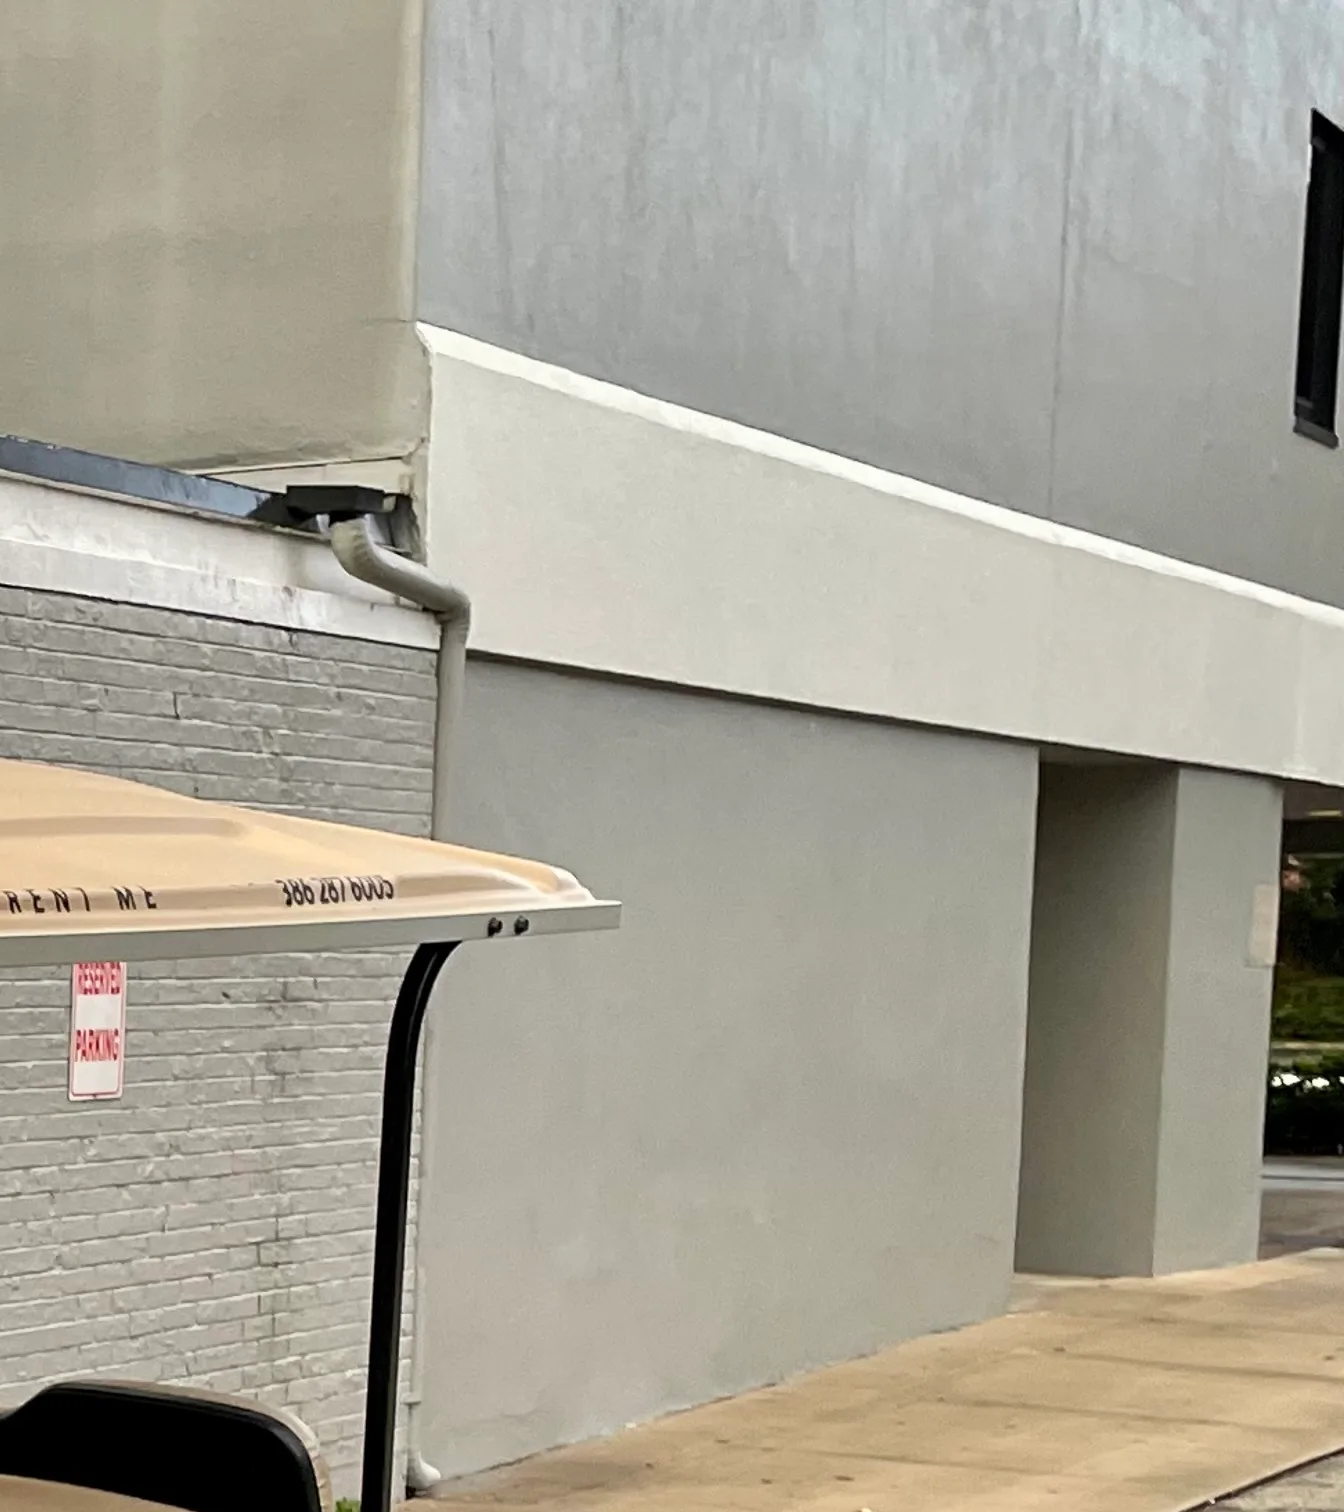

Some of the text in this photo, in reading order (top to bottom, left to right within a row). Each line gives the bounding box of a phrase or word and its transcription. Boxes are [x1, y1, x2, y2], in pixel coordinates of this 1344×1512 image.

[1, 885, 157, 914] RENT ME
[74, 1028, 120, 1062] PARKING
